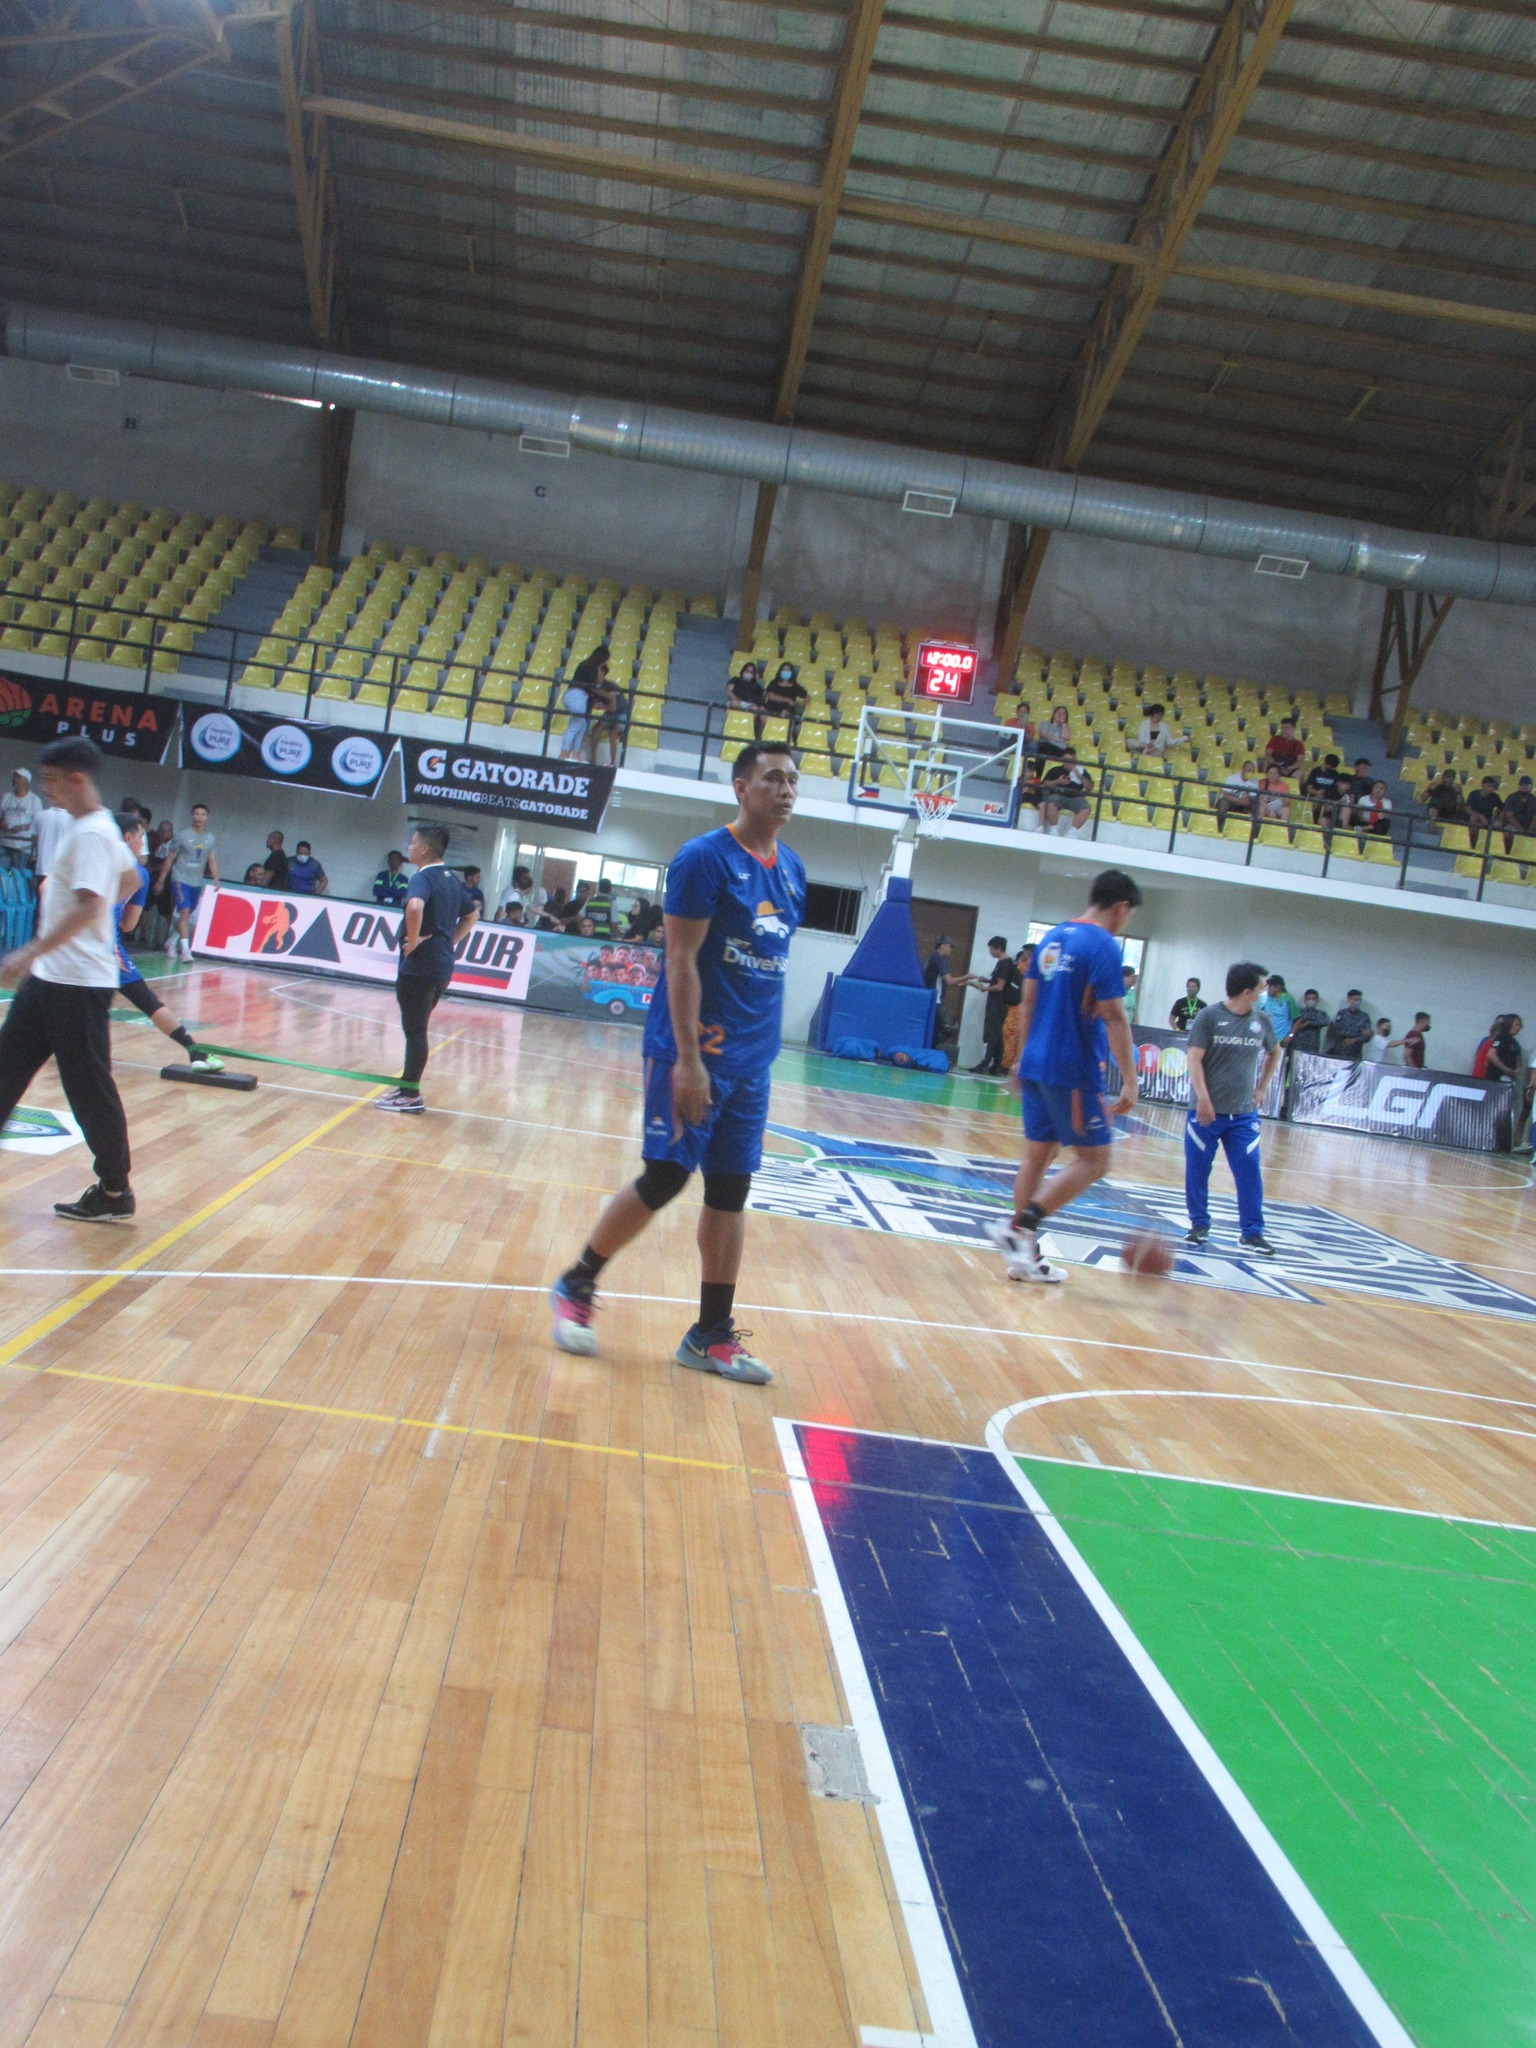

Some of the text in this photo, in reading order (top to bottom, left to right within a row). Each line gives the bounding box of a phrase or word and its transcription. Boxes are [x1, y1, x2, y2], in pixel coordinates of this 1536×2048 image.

[535, 485, 546, 498] C
[926, 651, 973, 670] 12:00.0
[929, 669, 958, 693] 24
[38, 693, 159, 732] ARENA
[56, 721, 137, 747] PLUS
[210, 727, 234, 737] Healthy
[208, 735, 232, 746] PURE
[280, 739, 303, 749] Healthy
[279, 747, 302, 758] PURE
[351, 751, 374, 760] Healthy
[349, 759, 372, 769] PURE
[452, 758, 591, 798] GATORADE
[413, 783, 589, 820] #NOTHINGBEATSGATORADE
[983, 803, 1006, 815] PBA
[206, 893, 524, 970] PBA ON UR
[1213, 1035, 1243, 1046] TOUGH
